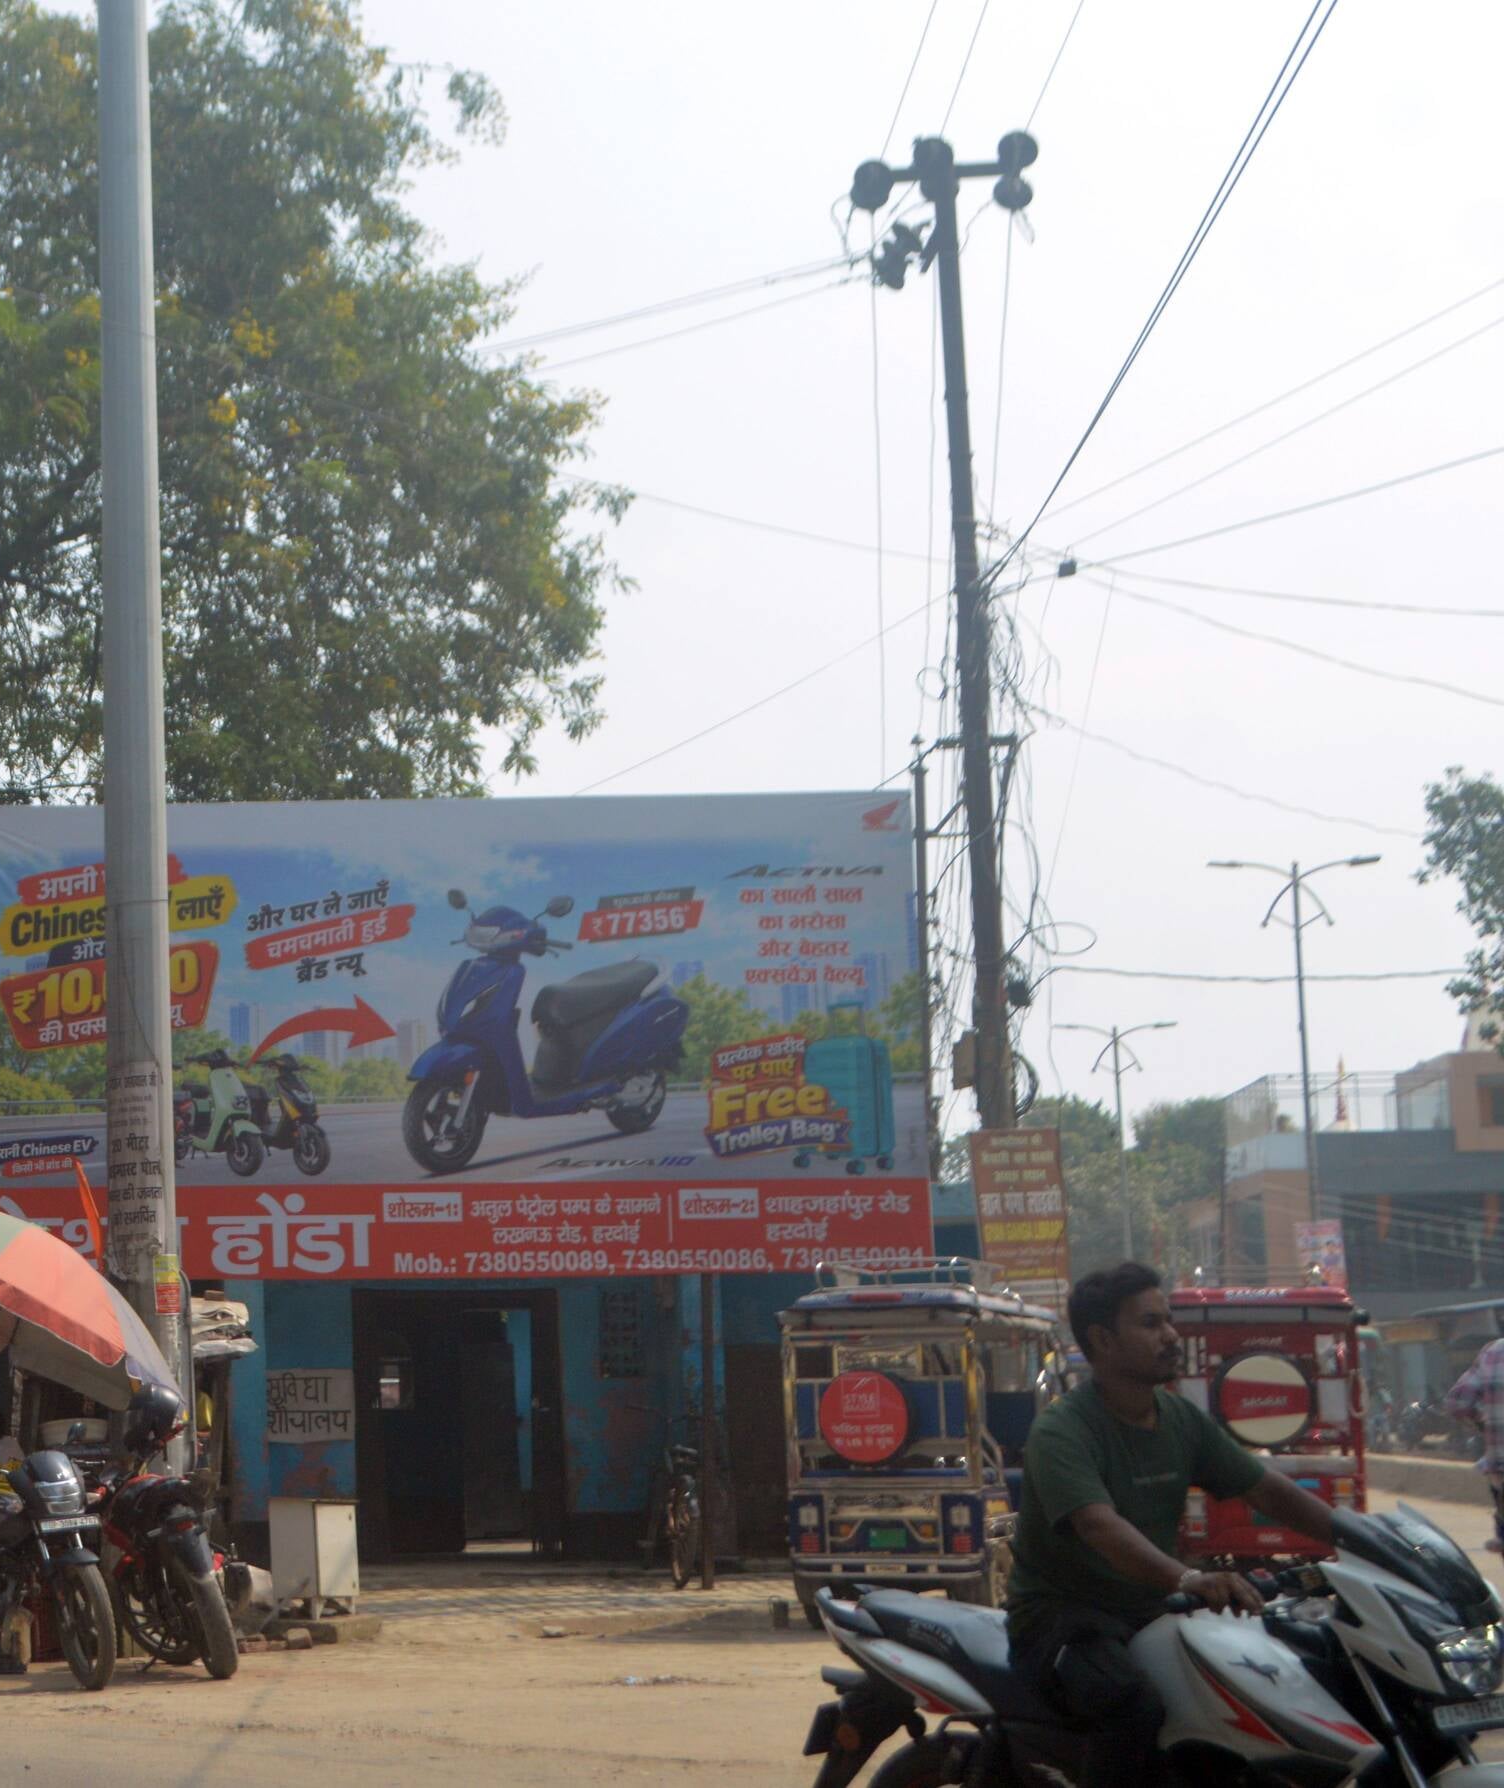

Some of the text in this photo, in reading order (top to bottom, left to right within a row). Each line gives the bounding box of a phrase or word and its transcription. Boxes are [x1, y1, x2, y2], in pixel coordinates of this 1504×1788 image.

[37, 868, 97, 900] अपनी
[739, 886, 765, 904] का
[823, 886, 863, 903] साल
[10, 903, 107, 947] Chines
[246, 908, 285, 933] और
[290, 904, 318, 927] घर
[322, 890, 341, 920] ले
[758, 911, 846, 931] का भरोसा
[266, 911, 388, 960] चमचमाती हुई
[758, 939, 850, 957] और बेहतर
[335, 952, 367, 978] न्यू
[39, 1021, 61, 1045] की
[732, 1063, 757, 1081] पर
[711, 1083, 829, 1129] Free
[21, 1140, 72, 1157] Chinese
[73, 1138, 93, 1154] EV
[714, 1124, 789, 1155] Trolley
[469, 1198, 512, 1224] अतुल
[515, 1193, 556, 1224] पेट्रोल
[560, 1198, 590, 1216] पम्प
[595, 1192, 611, 1214] के
[614, 1191, 661, 1214] सामने
[878, 1187, 911, 1212] रोड
[208, 1192, 375, 1275] होंडा
[492, 1225, 553, 1245] लखनऊ
[592, 1218, 641, 1245] हरदोई
[766, 1213, 828, 1241] हरदोई
[394, 1251, 457, 1274] Mob.:
[464, 1250, 615, 1276] 7380550089,
[622, 1248, 774, 1274] 7380550086,
